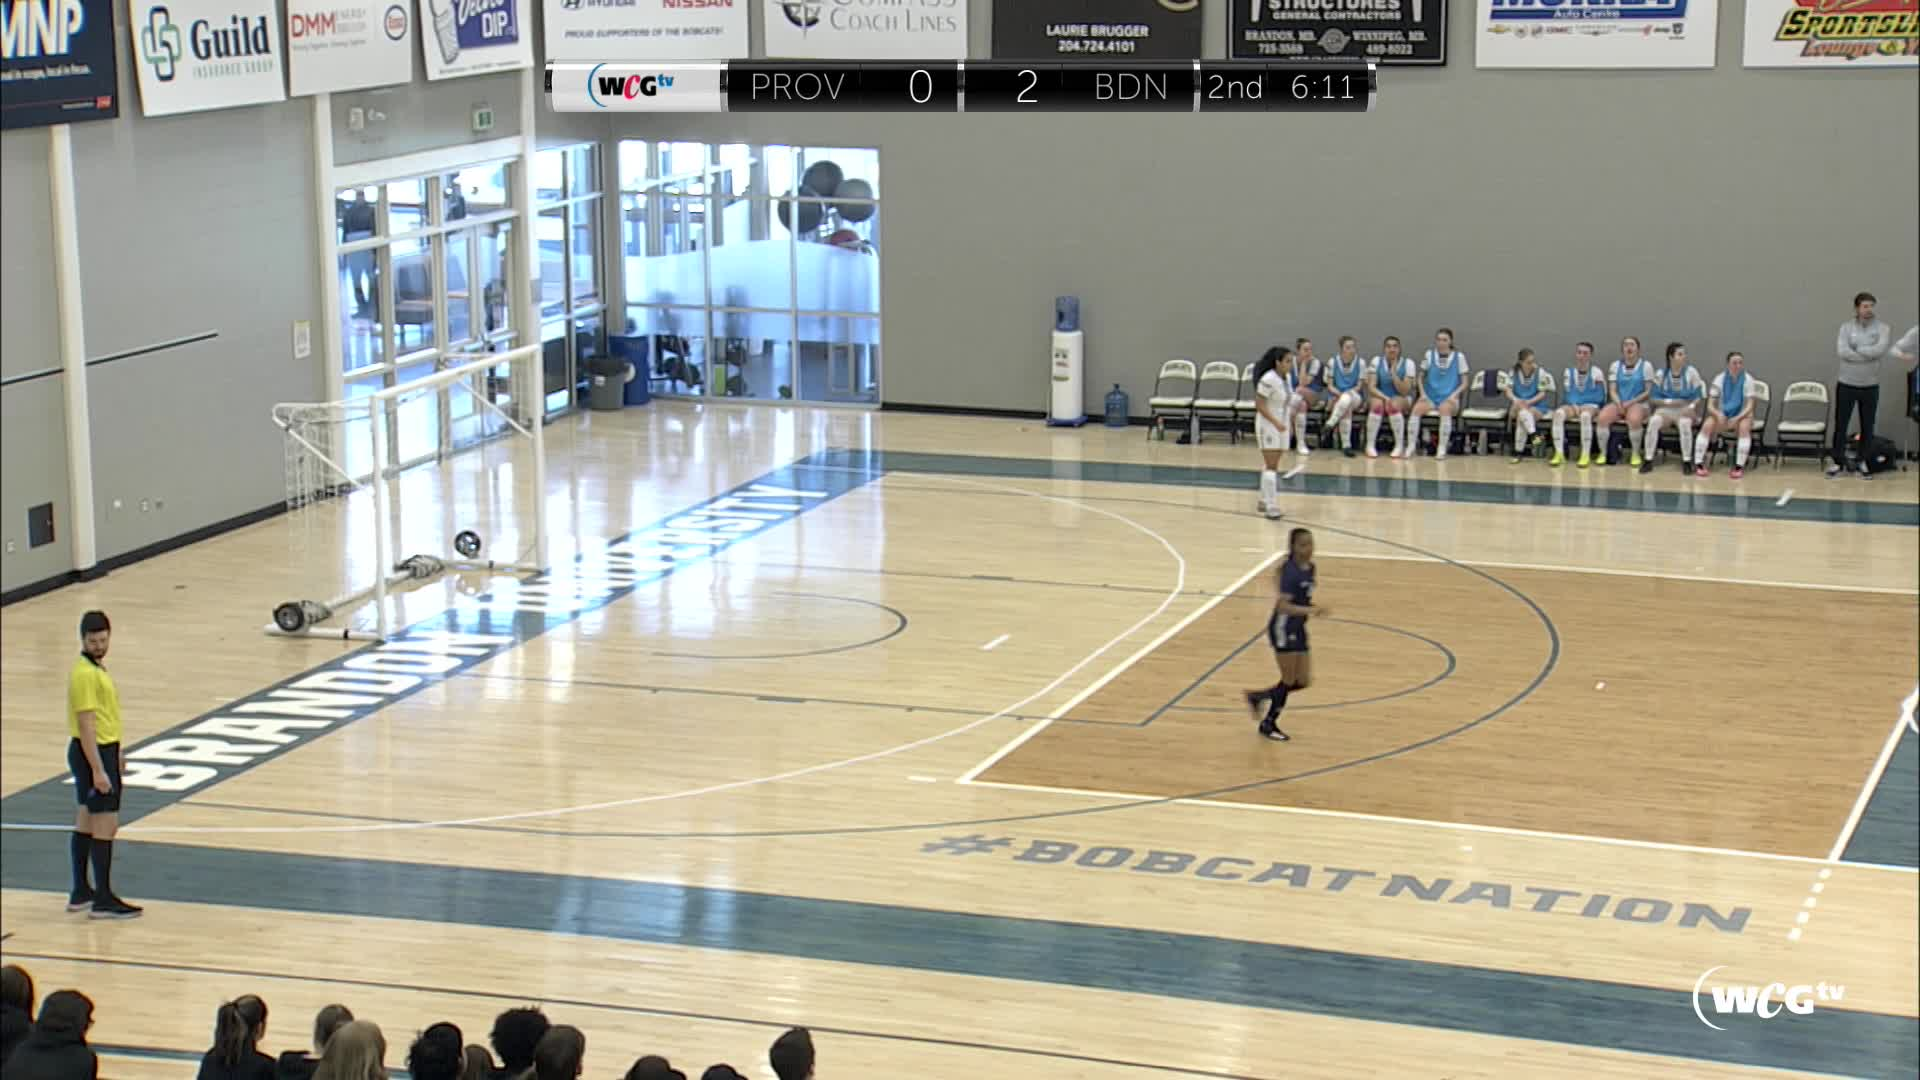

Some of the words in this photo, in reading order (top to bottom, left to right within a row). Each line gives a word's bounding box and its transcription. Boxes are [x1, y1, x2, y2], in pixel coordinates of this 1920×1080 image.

[662, 0, 733, 8] NISSAN
[1272, 11, 1321, 20] GENERAL
[1323, 11, 1402, 20] CONTRACTORS
[1, 0, 83, 57] MNP
[291, 12, 336, 37] DMM
[481, 10, 508, 38] DIP
[830, 8, 898, 32] COACH
[906, 8, 957, 33] LINES
[1046, 24, 1089, 37] LAURIE
[1090, 25, 1149, 38] BRUGGER
[190, 14, 272, 61] Guild
[61, 631, 518, 793] BRANDON
[487, 484, 829, 615] ERSITY
